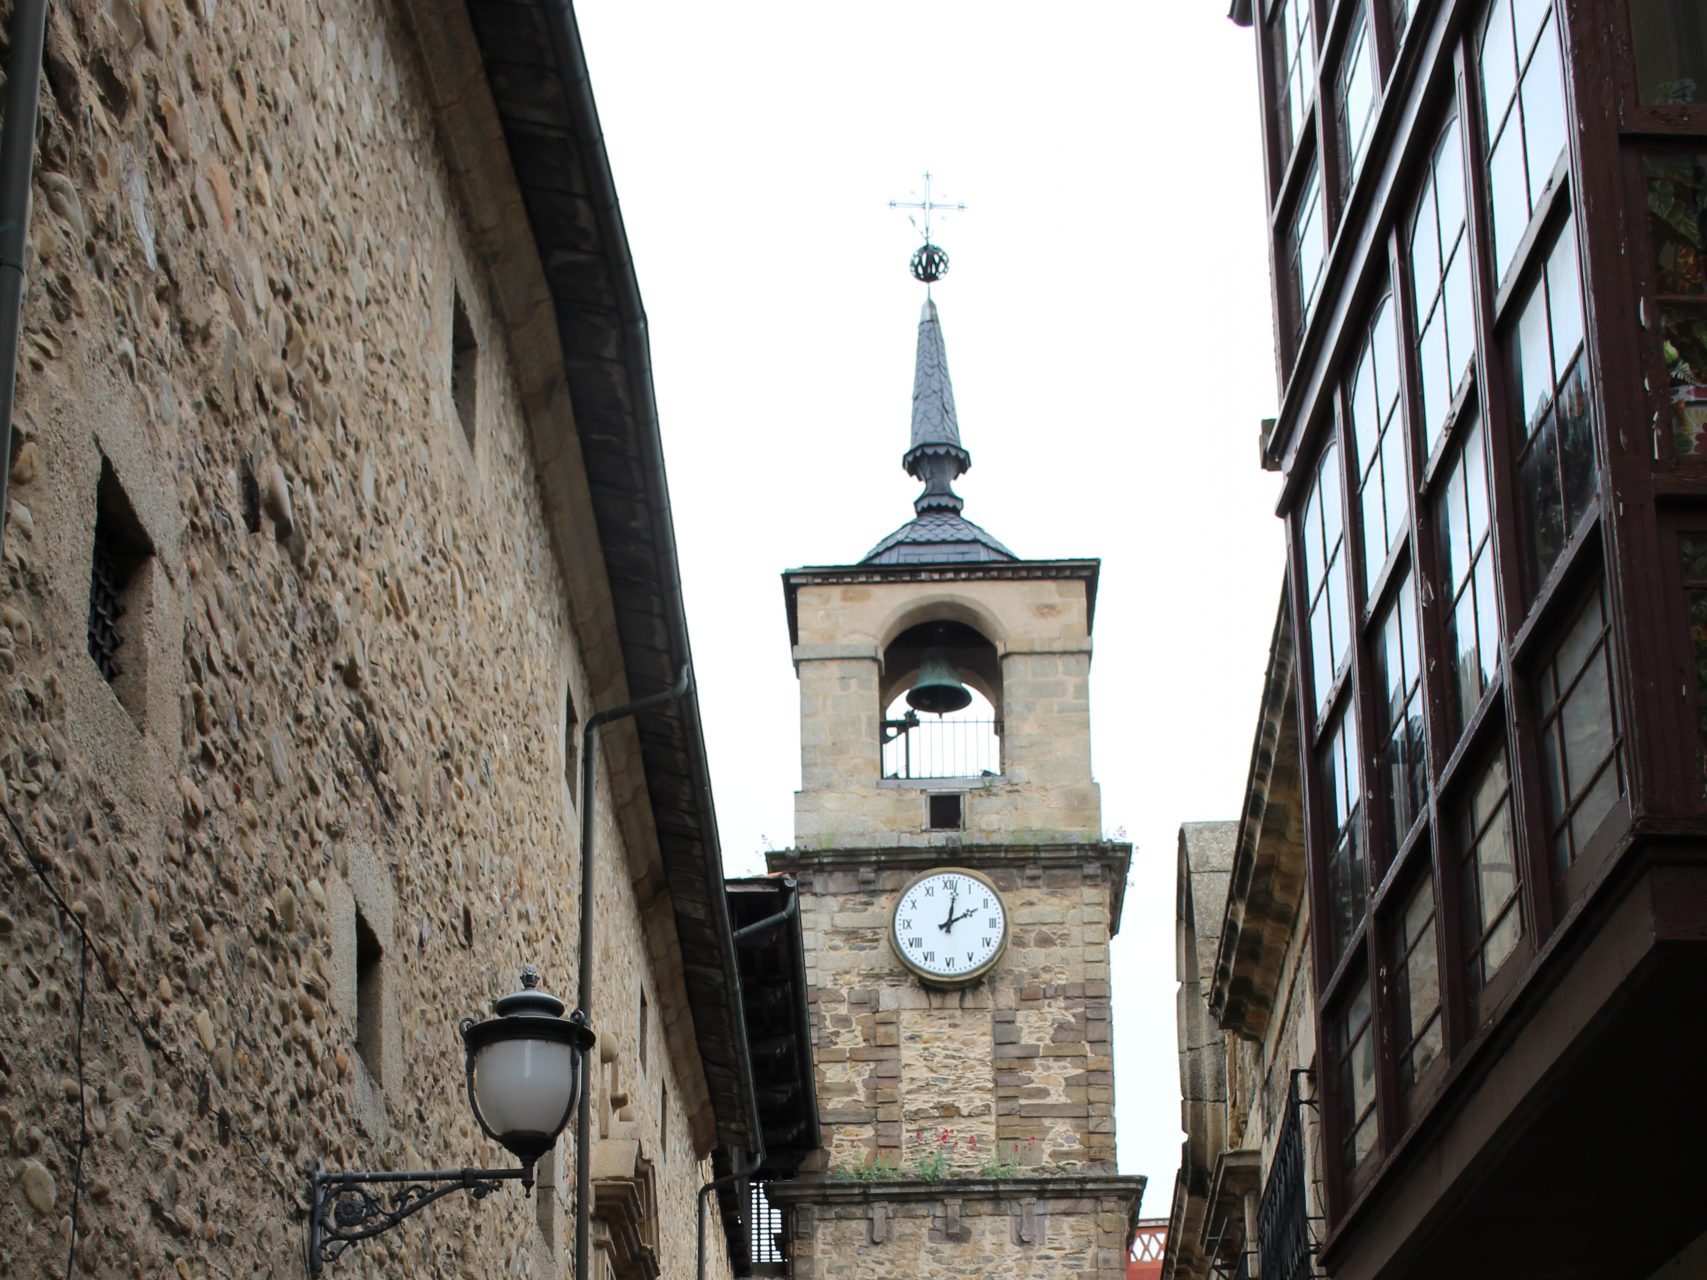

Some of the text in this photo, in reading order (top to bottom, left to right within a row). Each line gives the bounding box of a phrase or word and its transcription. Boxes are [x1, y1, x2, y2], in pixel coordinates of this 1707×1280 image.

[942, 880, 954, 890] XII
[925, 887, 934, 897] XI
[911, 899, 917, 910] X
[983, 898, 989, 909] II
[902, 919, 912, 930] IX
[989, 918, 997, 928] III
[908, 938, 922, 948] VIII
[982, 937, 992, 947] IV
[922, 952, 935, 962] VII
[967, 952, 974, 962] V
[945, 957, 954, 968] VI
